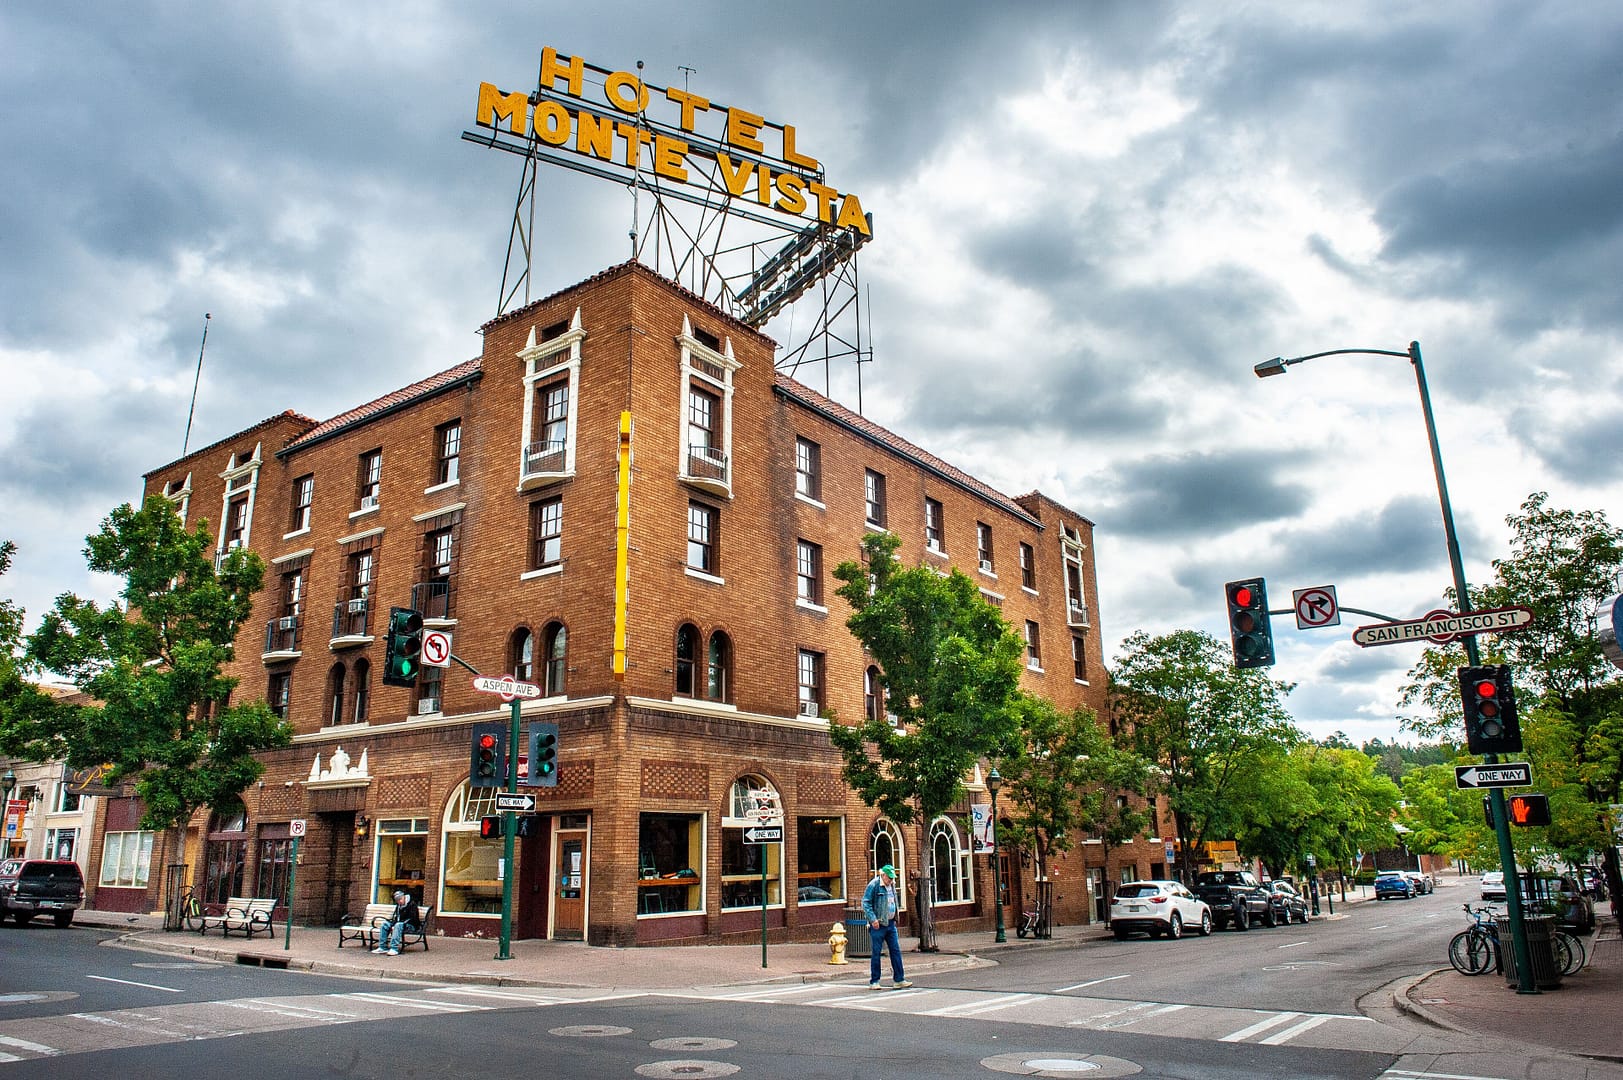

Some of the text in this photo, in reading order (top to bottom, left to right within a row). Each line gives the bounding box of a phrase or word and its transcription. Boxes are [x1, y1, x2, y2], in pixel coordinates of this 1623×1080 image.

[539, 46, 818, 170] HOTEL
[476, 82, 870, 236] MONTE VISTA
[1367, 612, 1518, 642] SAN FRANCISCO ST
[483, 680, 533, 695] ASPEN AVE
[1478, 771, 1522, 781] ONE WAY
[500, 798, 511, 806] ONE
